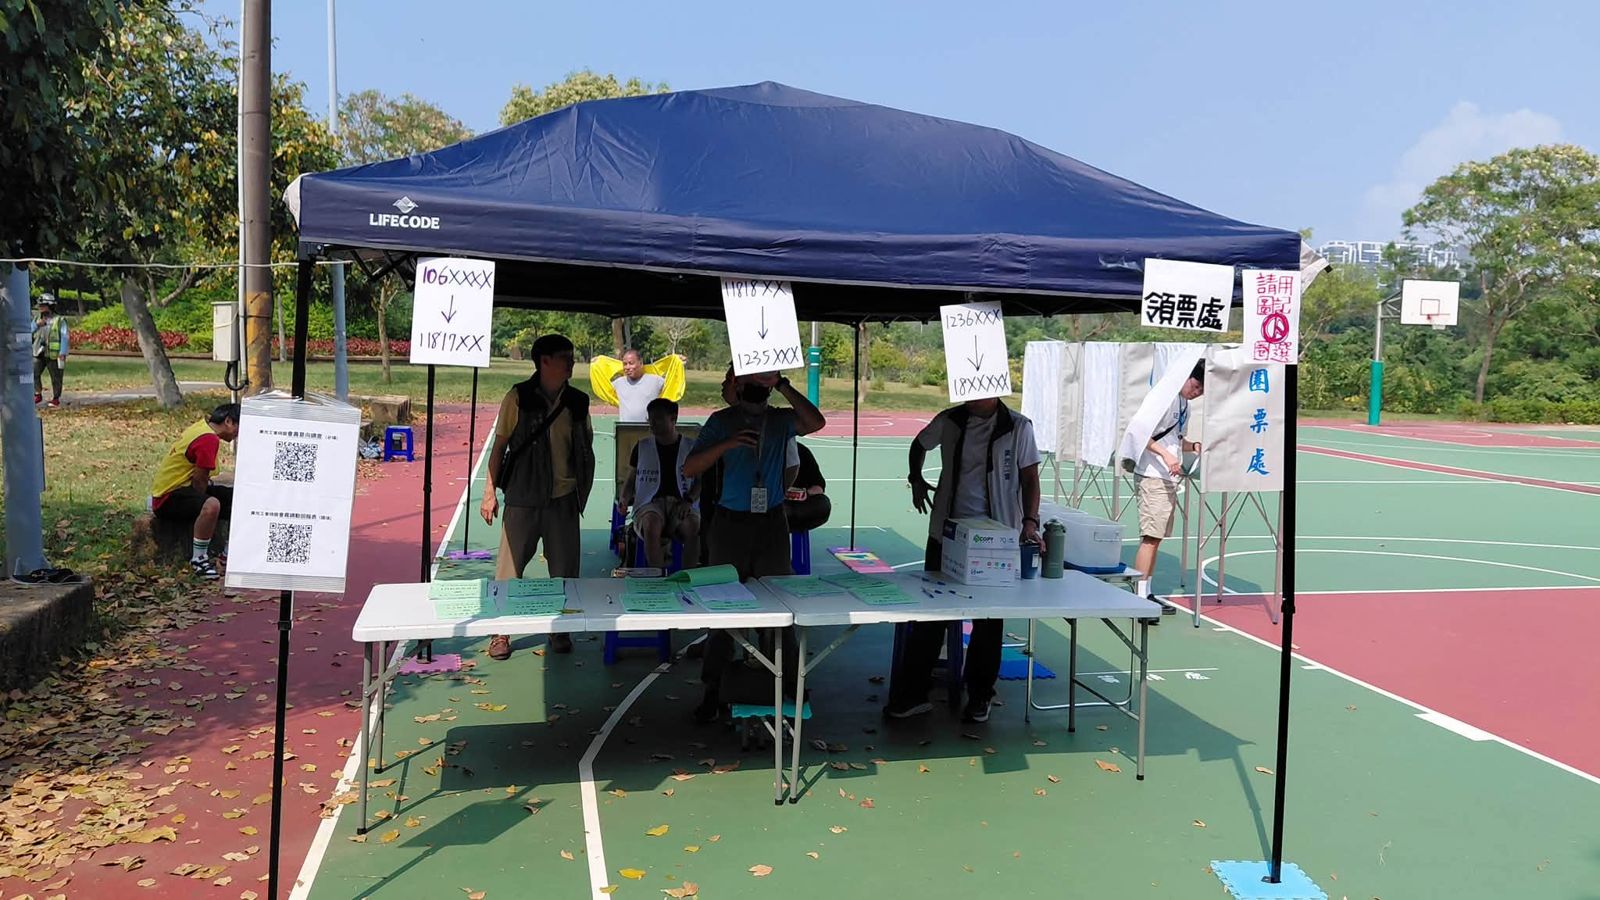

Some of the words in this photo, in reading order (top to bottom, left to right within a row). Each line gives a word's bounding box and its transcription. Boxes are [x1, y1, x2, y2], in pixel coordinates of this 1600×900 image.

[369, 213, 440, 230] LIFECODE
[422, 265, 493, 290] 106XXXX
[1256, 272, 1293, 296] 請用
[945, 308, 1001, 330] 1236XXX
[1144, 291, 1225, 331] 領票處
[737, 345, 799, 370] 1235XXX
